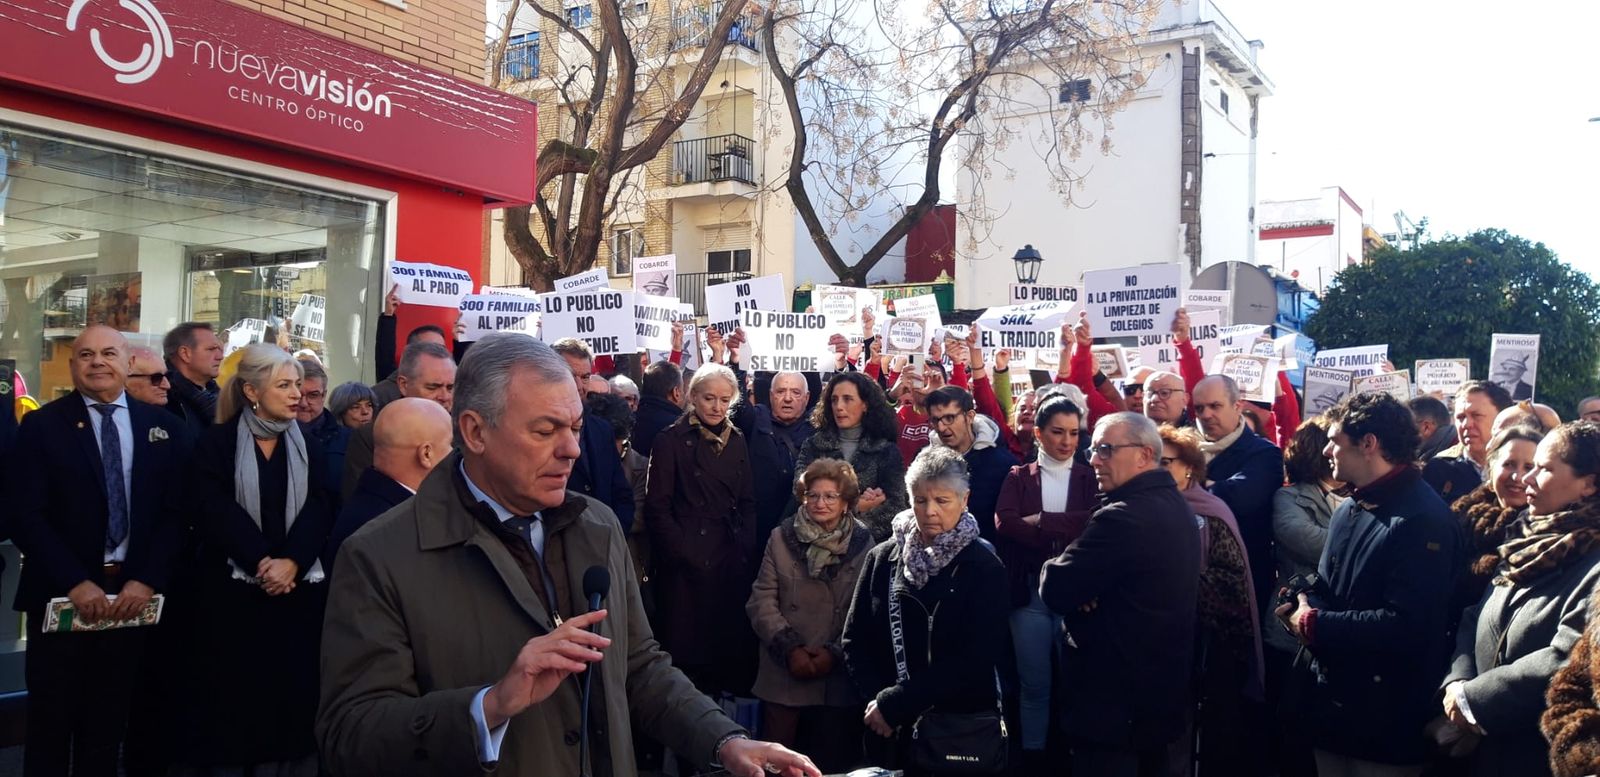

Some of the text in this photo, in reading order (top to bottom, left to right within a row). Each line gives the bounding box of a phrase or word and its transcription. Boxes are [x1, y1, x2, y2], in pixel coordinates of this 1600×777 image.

[228, 86, 364, 132] CENTRO ÓPTICO
[639, 260, 670, 270] COBARDE
[391, 266, 472, 282] 300 FAMILIAS
[1125, 275, 1138, 288] NO
[412, 279, 460, 297] AL PARO
[563, 274, 600, 290] COBARDE
[736, 283, 751, 297] NO
[1015, 286, 1078, 303] LO PUBLICO
[1087, 285, 1177, 304] A LA PRIVATIZACIÓN
[545, 293, 623, 314] LO PUBLICO
[1188, 294, 1223, 303] COBARDE
[460, 300, 542, 313] 300 FAMILIAS
[1103, 303, 1161, 318] LIMPIEZA DE
[478, 316, 527, 331] AL PARO
[576, 316, 596, 333] NO
[745, 312, 827, 331] LO PUBLICO
[1000, 314, 1037, 326] SANZ
[1110, 318, 1155, 332] COLEGIOS
[775, 333, 796, 350] NO
[982, 331, 1056, 349] EL TRAIDOR
[1158, 348, 1172, 363] AL
[1316, 353, 1387, 368] 300 FAMILIAS
[750, 355, 819, 372] SE VENDE
[1308, 370, 1350, 382] MENTIROSO
